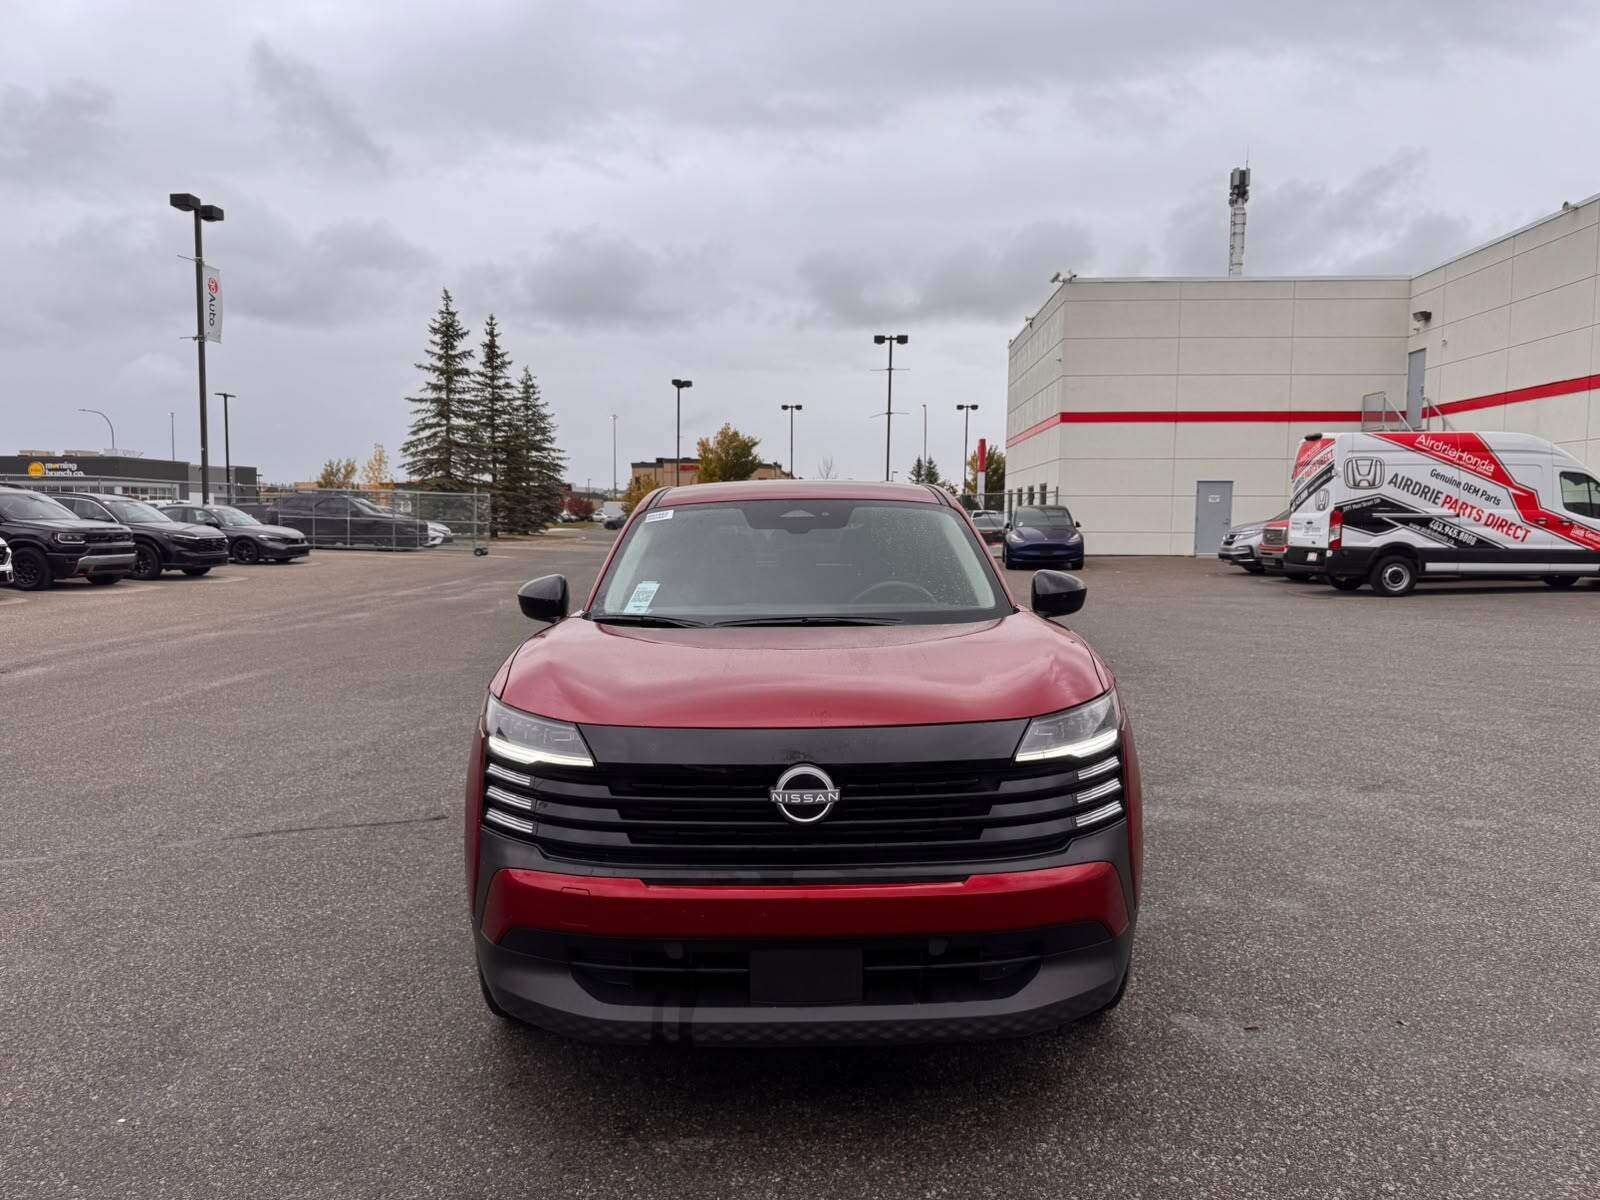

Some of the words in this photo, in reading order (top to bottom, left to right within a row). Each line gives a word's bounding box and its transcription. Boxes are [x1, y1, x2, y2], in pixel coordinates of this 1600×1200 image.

[208, 292, 216, 327] Auto
[45, 461, 78, 471] morning
[45, 469, 72, 477] brunch
[1430, 468, 1462, 489] Genuine
[1462, 482, 1480, 497] OEM
[1479, 490, 1502, 506] Parts
[1387, 472, 1444, 507] AIRDRIE
[1440, 494, 1485, 524] PARTS
[1483, 512, 1531, 543] DIRECT
[772, 792, 839, 803] NISSAN
